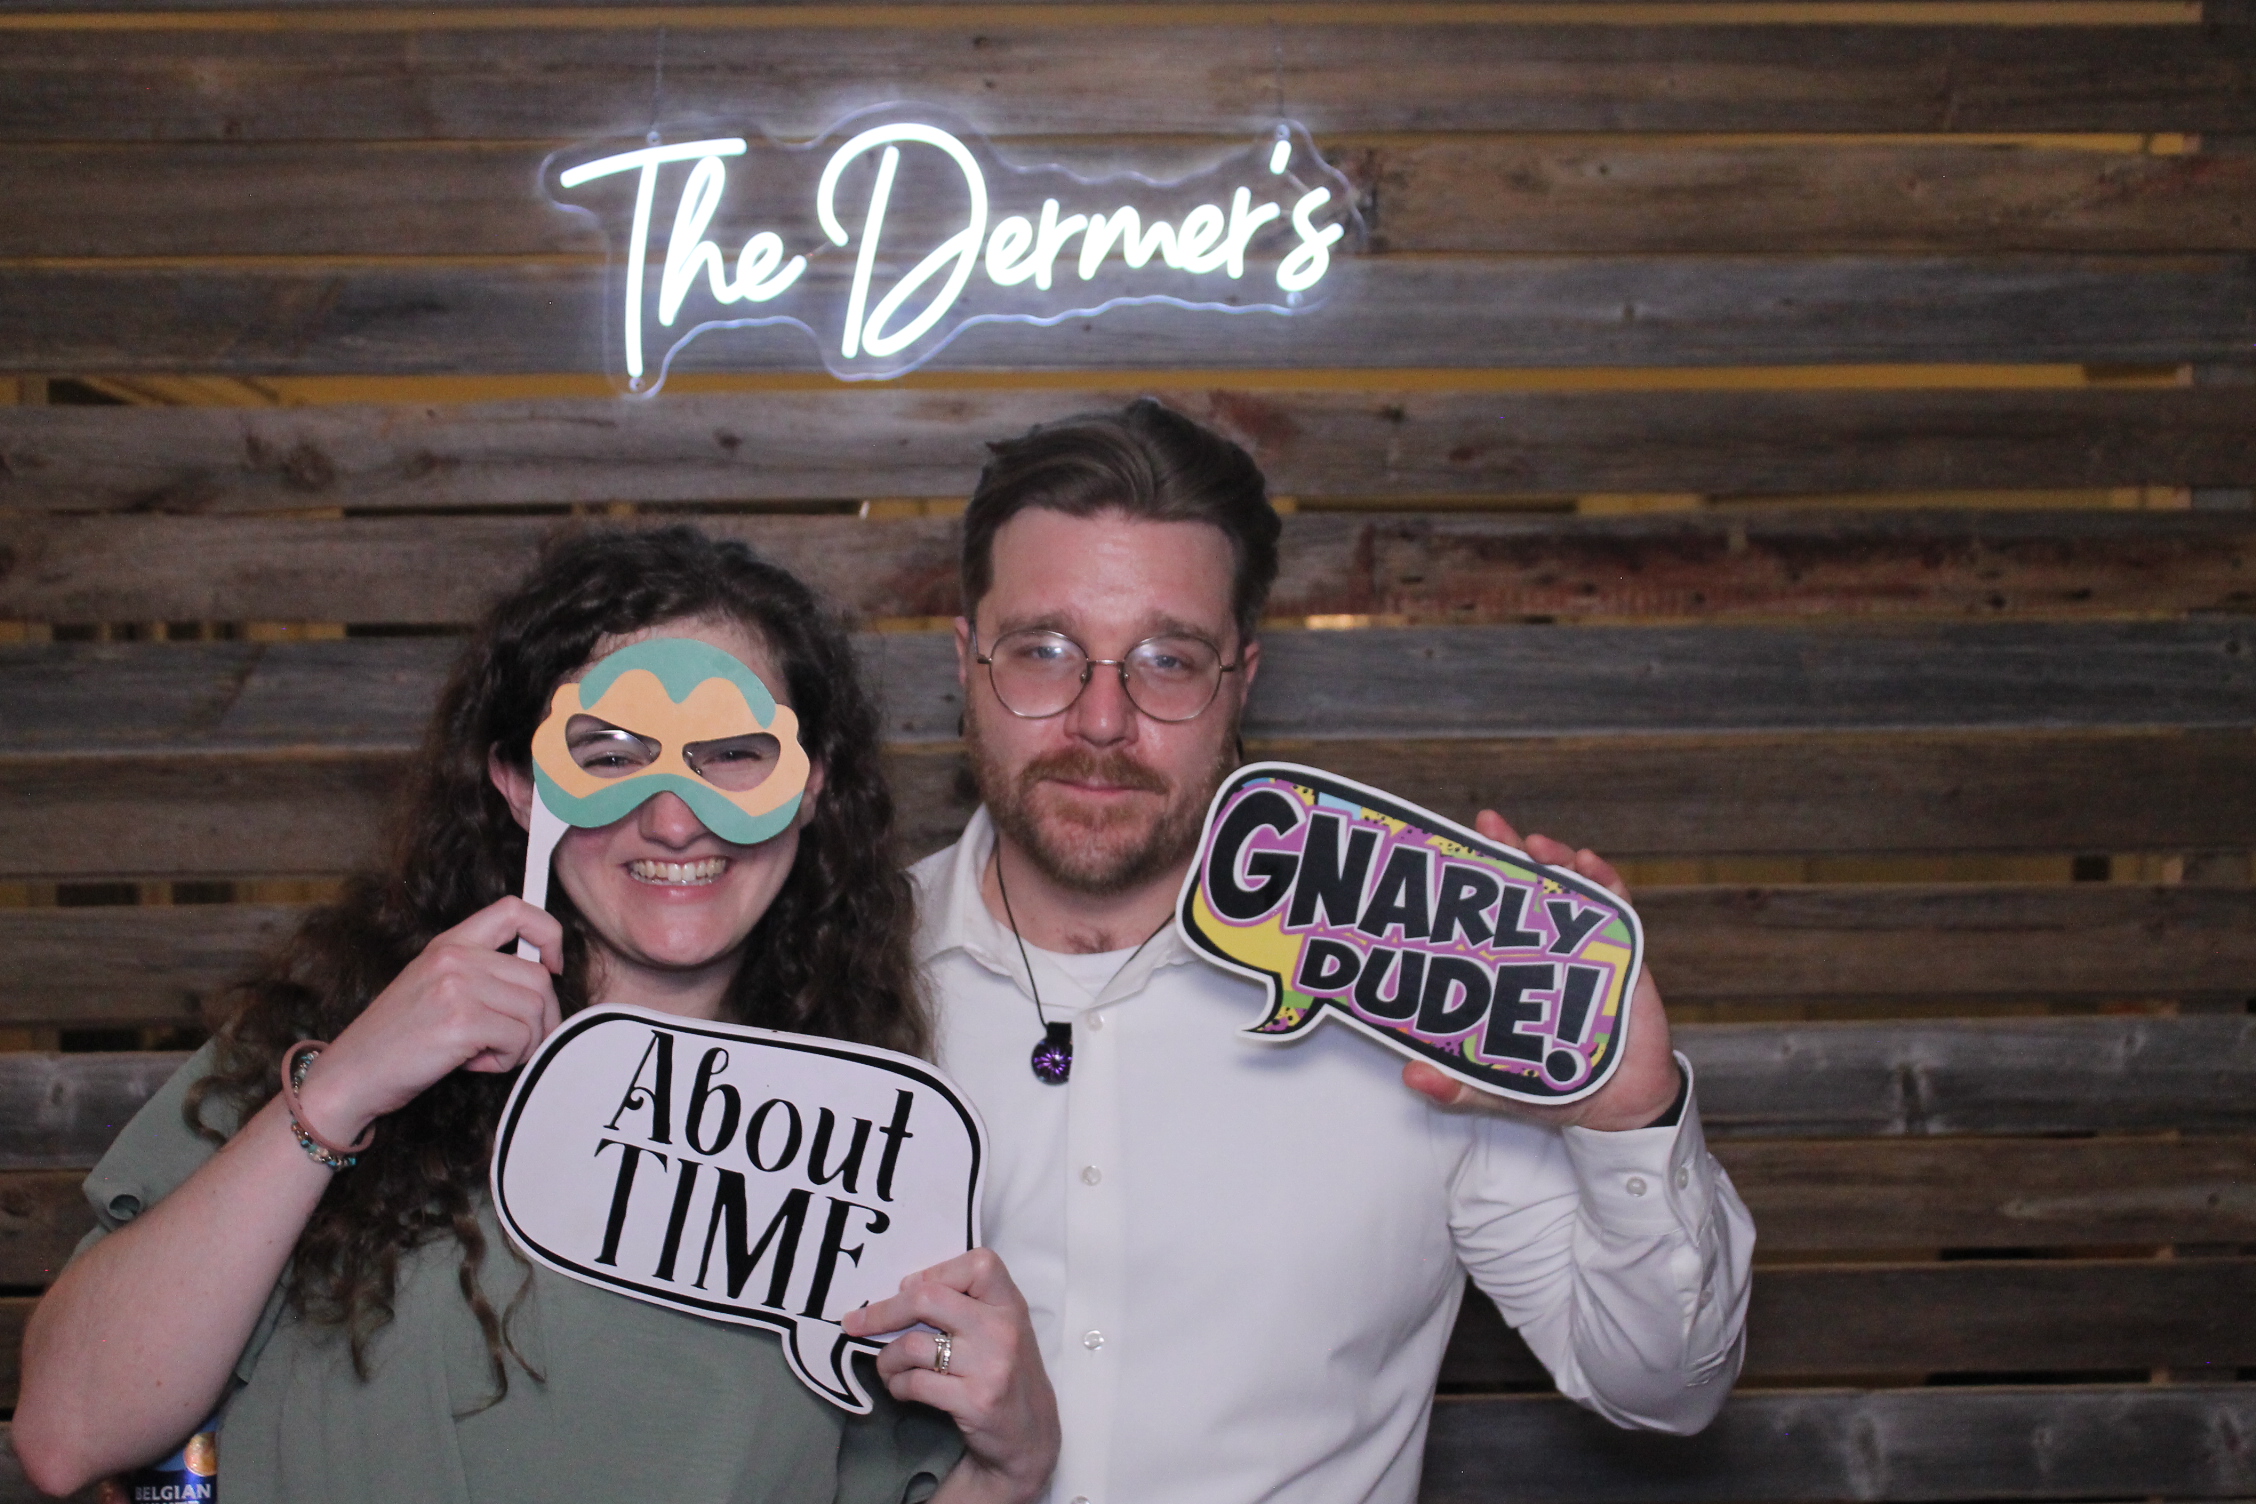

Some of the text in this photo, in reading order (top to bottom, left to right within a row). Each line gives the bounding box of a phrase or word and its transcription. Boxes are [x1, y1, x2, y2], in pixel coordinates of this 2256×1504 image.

[560, 123, 1343, 378] The Dermer's
[1208, 789, 1607, 955] GNARLY
[1299, 937, 1600, 1083] DUDE!
[603, 1029, 914, 1202] About
[594, 1138, 891, 1326] TIME
[135, 1484, 212, 1500] BELGIAN
